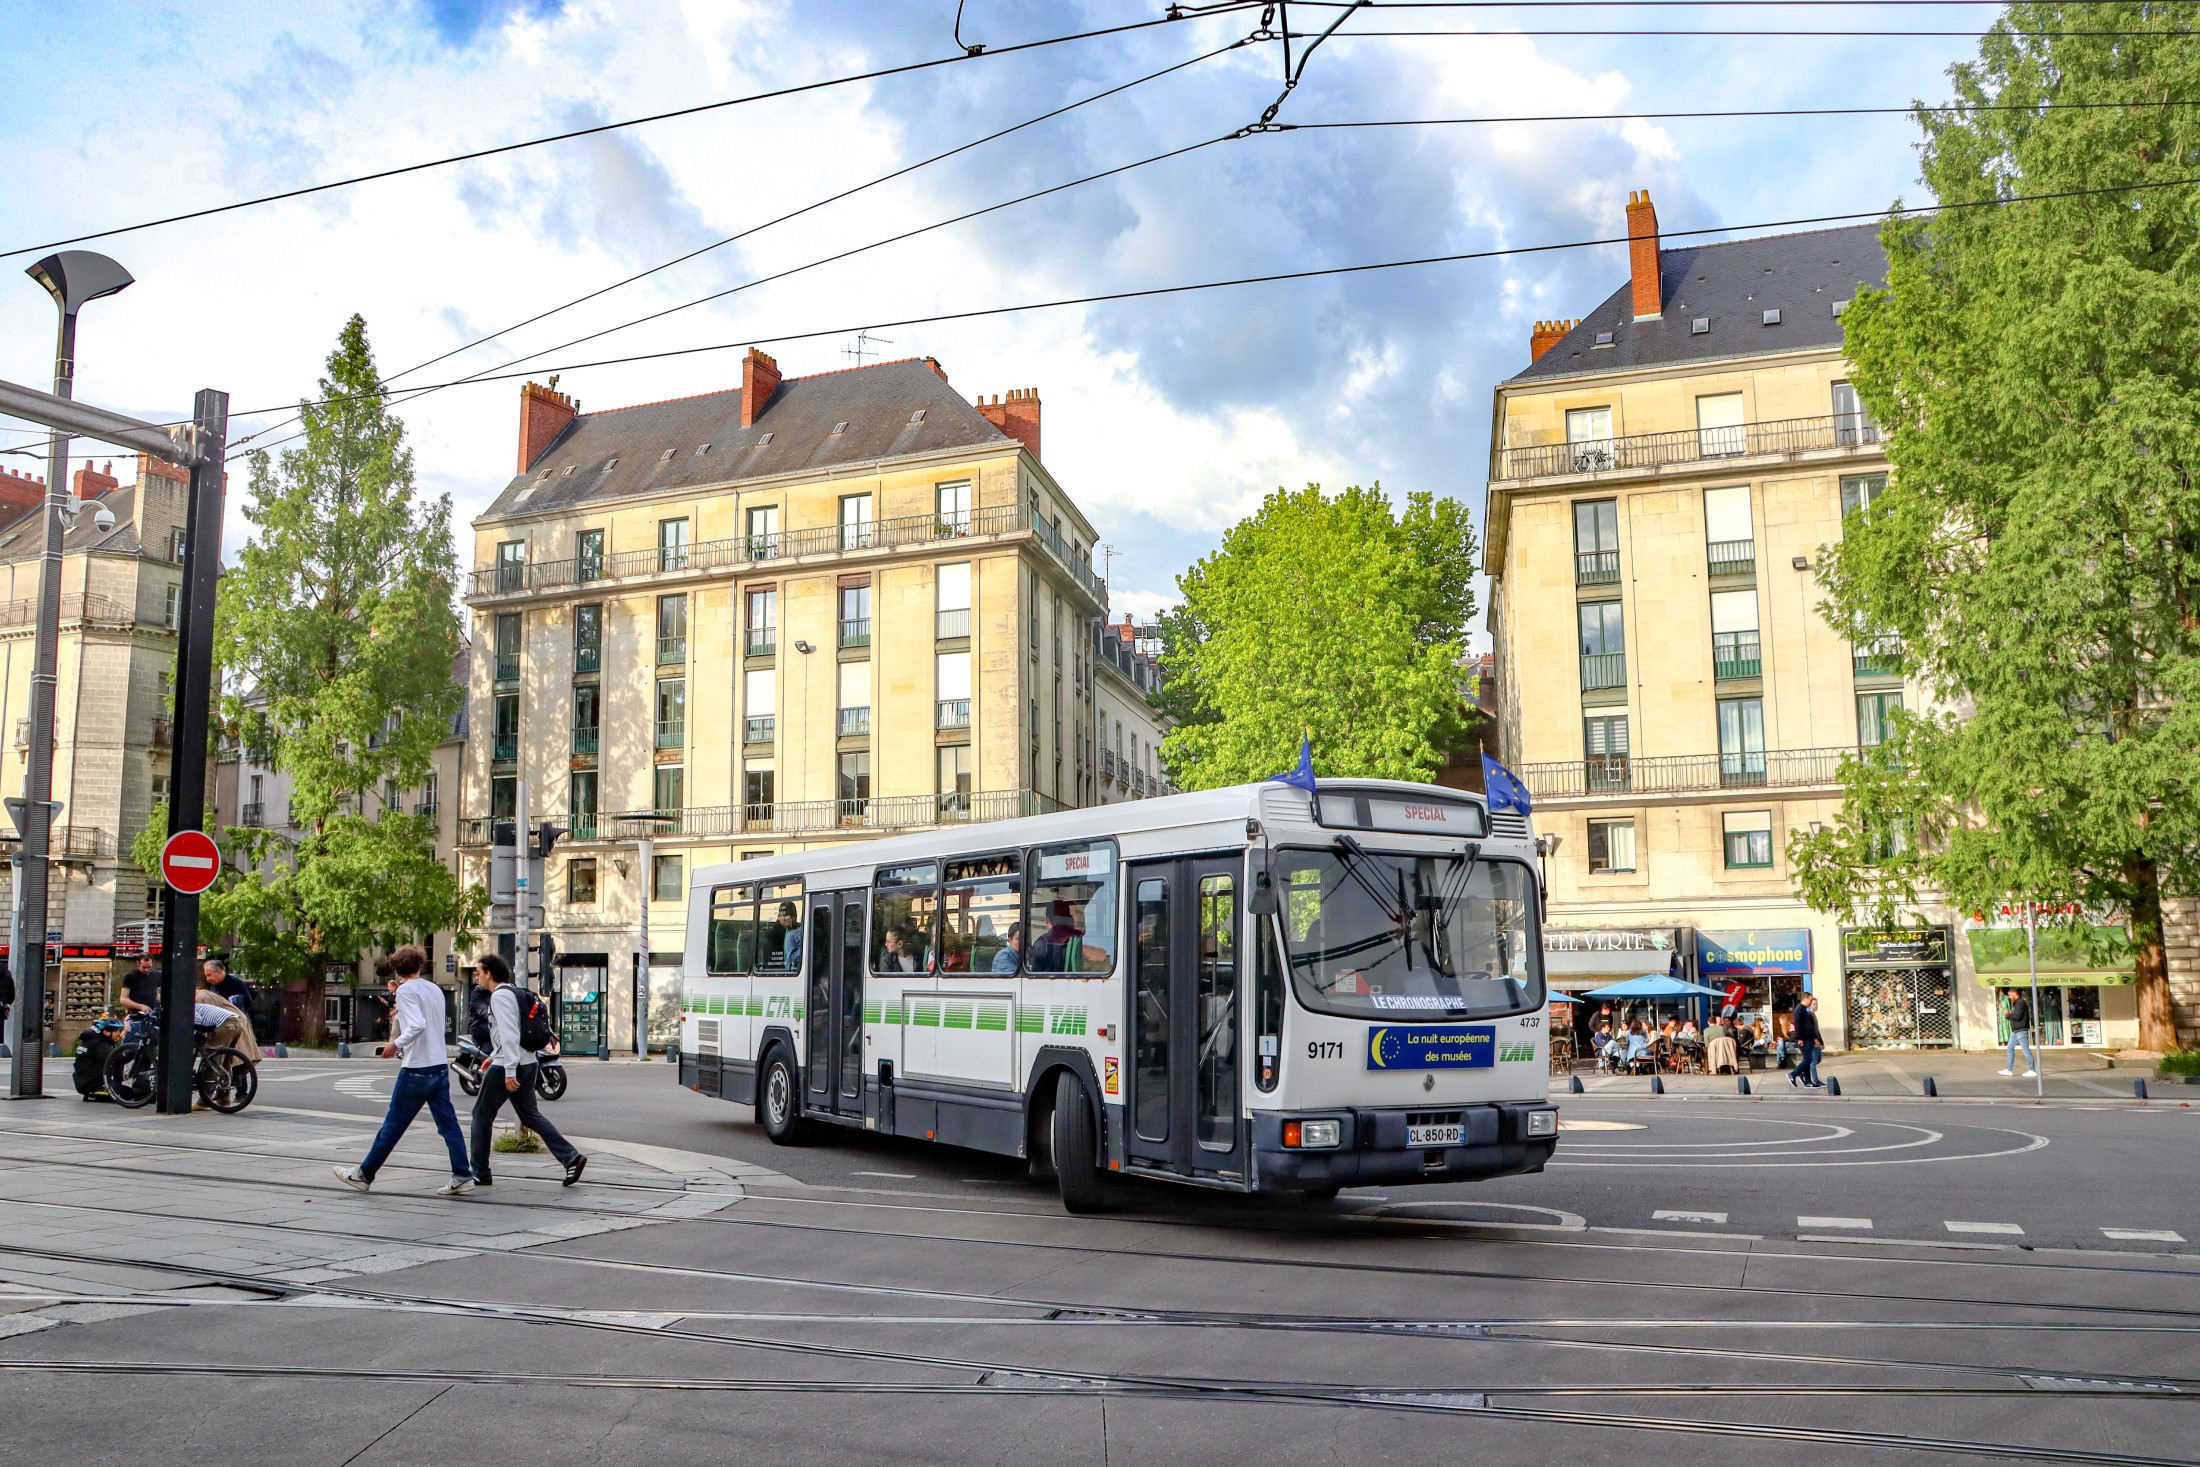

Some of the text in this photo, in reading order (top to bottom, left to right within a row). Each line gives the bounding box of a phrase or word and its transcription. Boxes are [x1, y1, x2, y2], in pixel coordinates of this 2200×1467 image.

[1405, 805, 1447, 821] SPECIAL
[1065, 855, 1090, 871] SPECIAL
[1583, 933, 1645, 951] VERTE
[1373, 997, 1466, 1010] LE CHRONOGRAPHE
[1050, 1005, 1088, 1035] TAN
[1520, 1018, 1540, 1028] 4737
[1408, 1033, 1490, 1045] La nuit européenne
[1308, 1041, 1343, 1059] 9171
[1425, 1051, 1472, 1062] des musées
[1498, 1041, 1536, 1062] TAN
